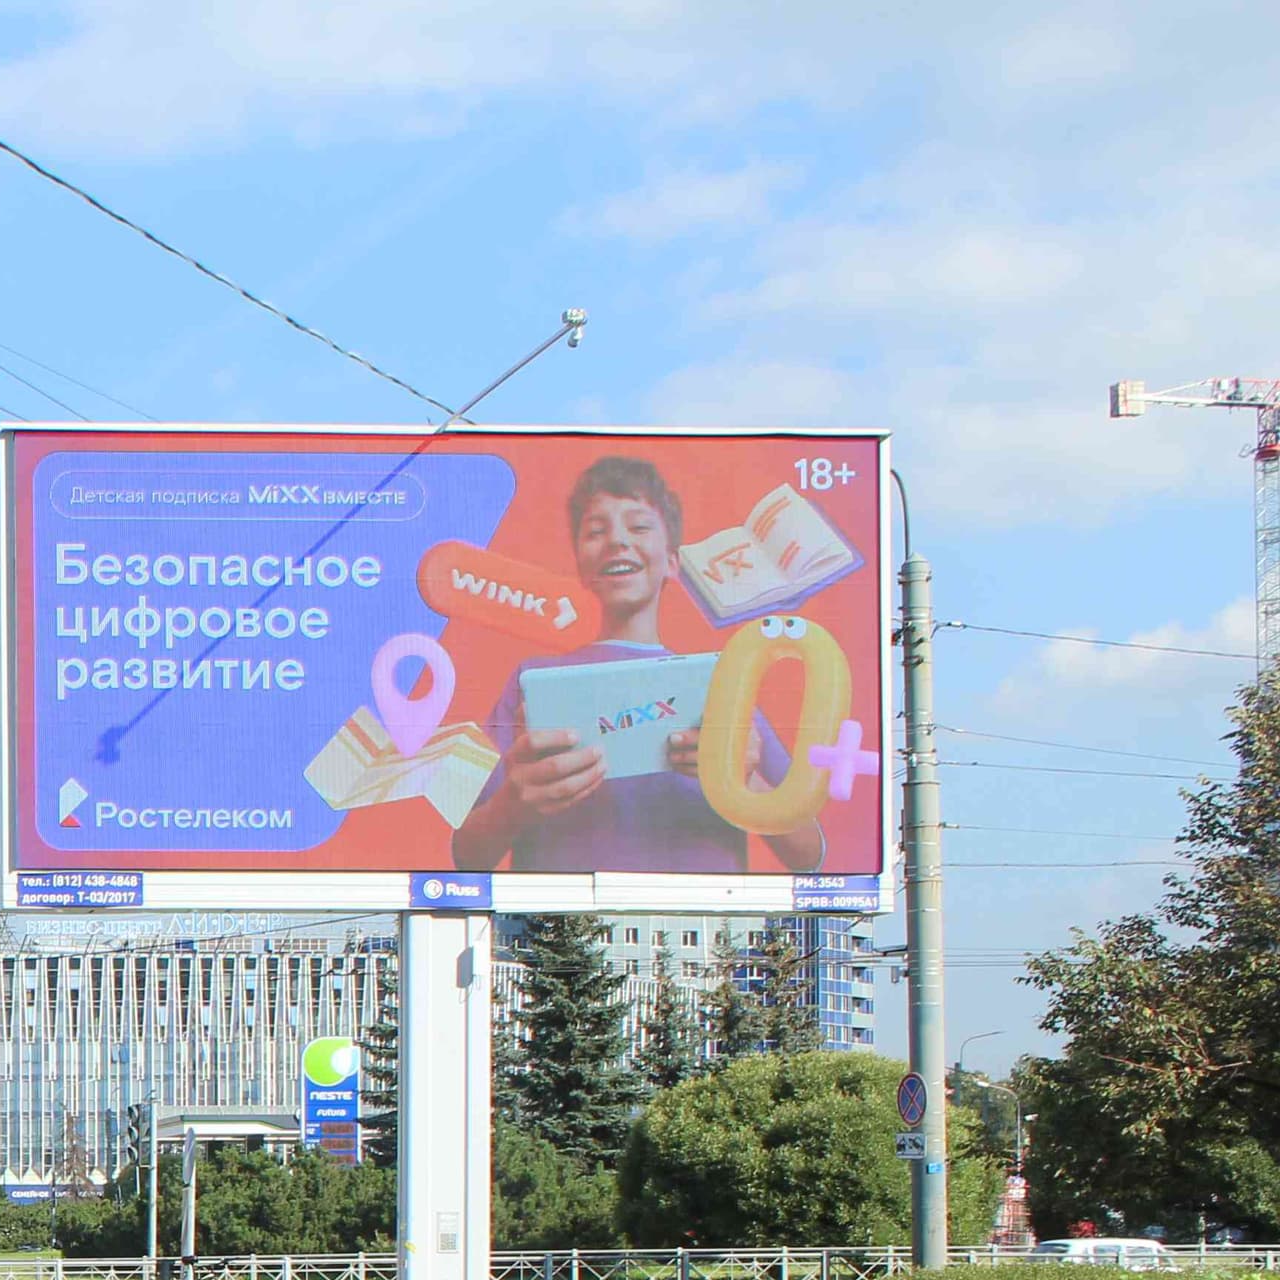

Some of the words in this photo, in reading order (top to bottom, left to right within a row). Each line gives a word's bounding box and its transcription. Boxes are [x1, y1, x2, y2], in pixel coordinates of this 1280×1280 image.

[794, 457, 856, 491] 18+
[70, 486, 144, 505] Детская
[151, 488, 240, 506] подписка
[323, 490, 407, 505] ВМЕСТЕ
[55, 543, 382, 588] Безопасное
[450, 568, 549, 617] WINK
[55, 595, 330, 649] цифровое
[56, 657, 306, 700] развитие
[95, 802, 292, 829] Ростелеком
[22, 876, 51, 887] тел.:
[52, 875, 82, 888] (812)
[84, 875, 138, 887] 438-4848
[445, 883, 481, 896] Russ
[22, 892, 74, 905] договор:
[77, 892, 136, 904] Т-03/2017
[309, 1091, 353, 1101] NESTE
